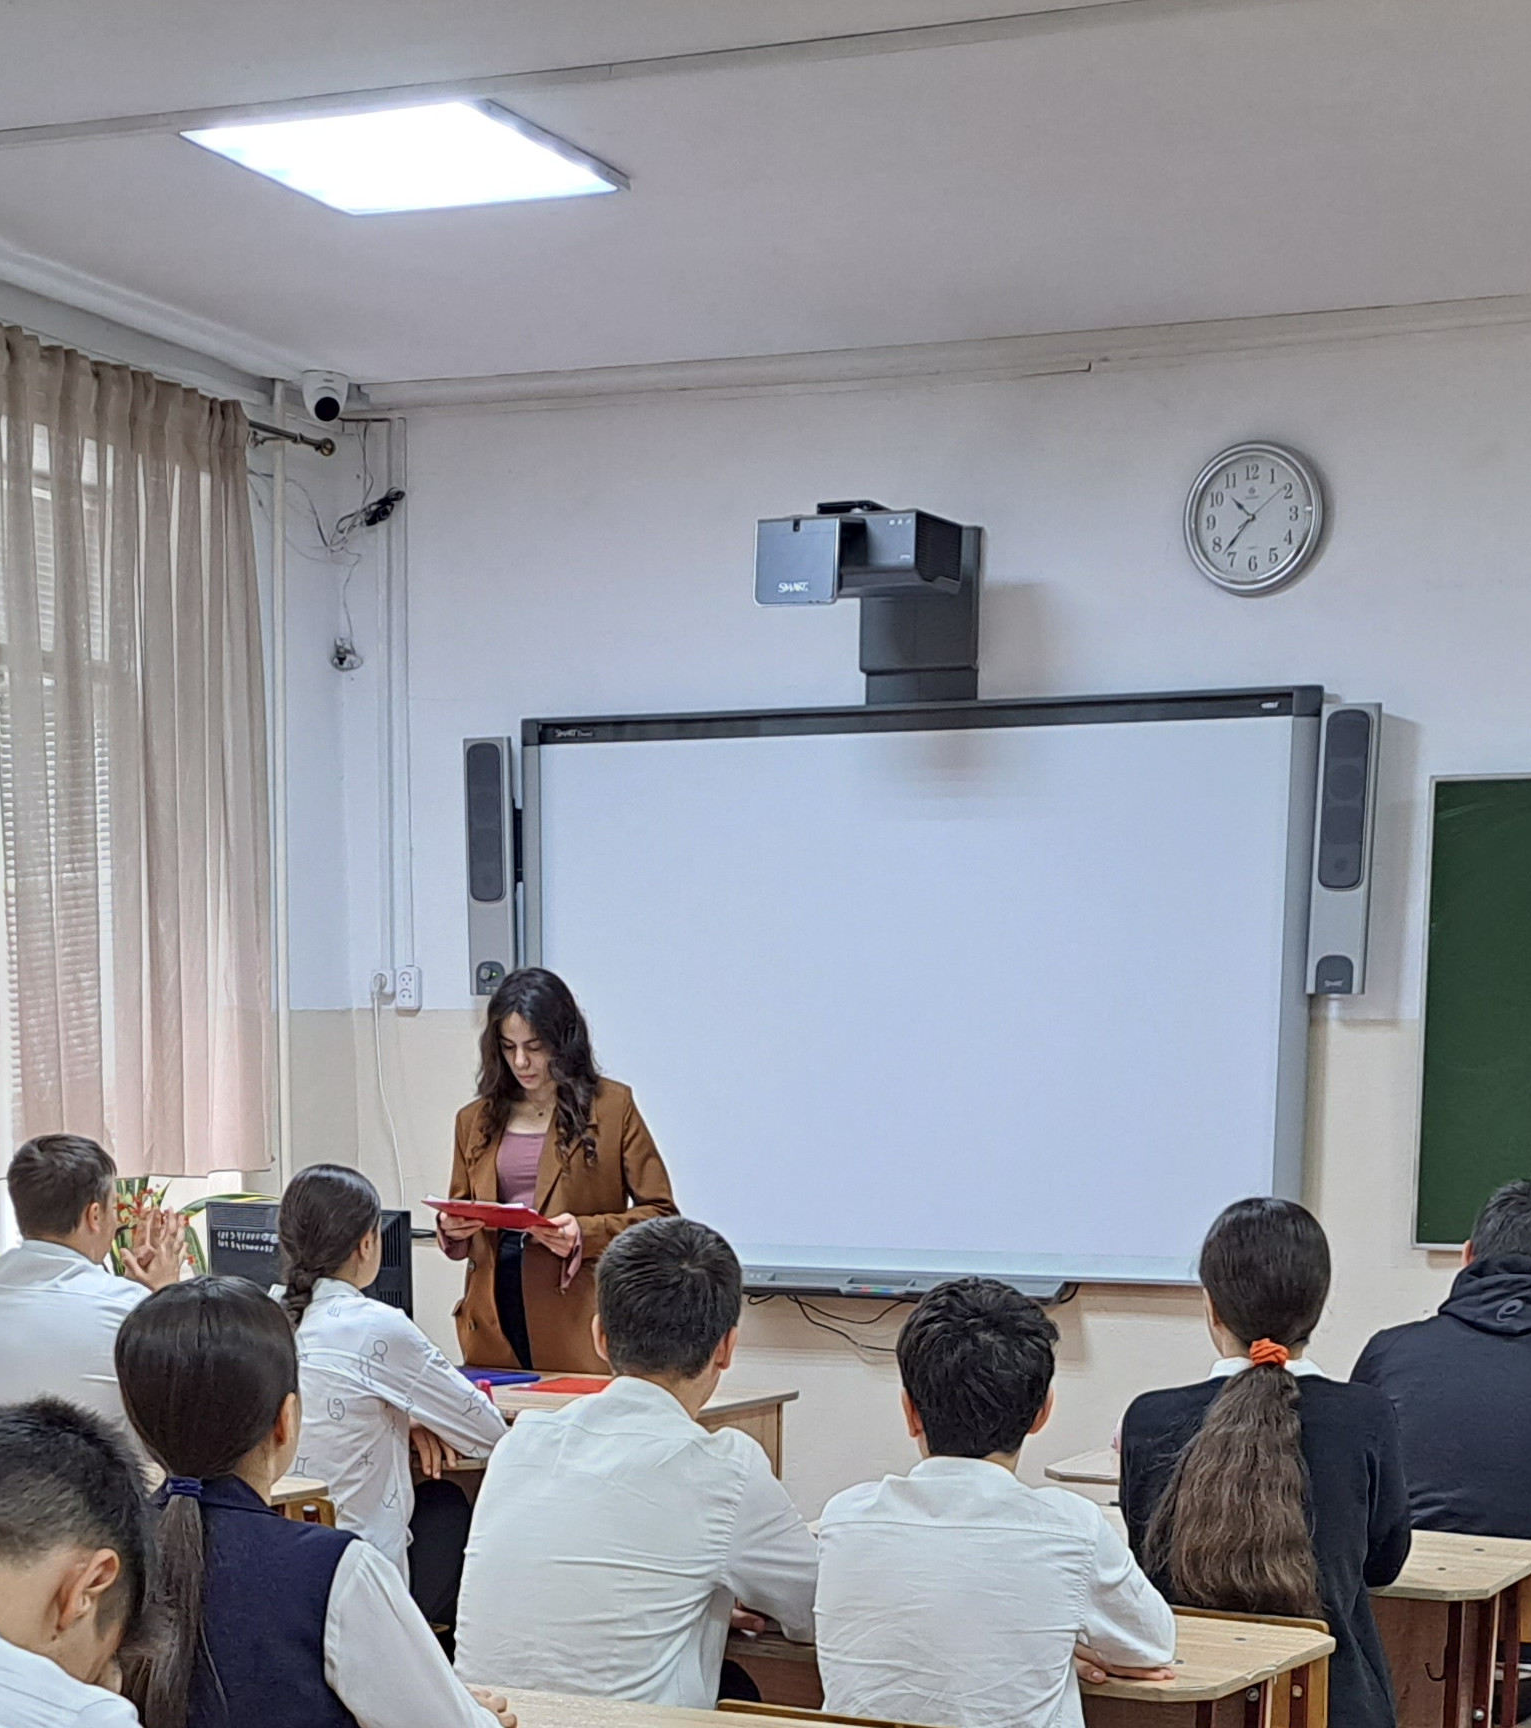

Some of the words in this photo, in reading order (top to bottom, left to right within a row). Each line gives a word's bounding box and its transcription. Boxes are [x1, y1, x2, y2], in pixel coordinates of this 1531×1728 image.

[1224, 472, 1237, 489] 11
[1245, 463, 1260, 481] 12
[1269, 468, 1275, 484] 1
[1210, 490, 1224, 508] 10
[1283, 482, 1293, 500] 2
[1289, 505, 1299, 521] 3
[1206, 514, 1216, 531] 9
[1212, 536, 1222, 553] 8
[1283, 528, 1292, 545] 4
[1227, 551, 1237, 568] 7
[1248, 555, 1258, 572] 6
[1268, 546, 1279, 564] 5
